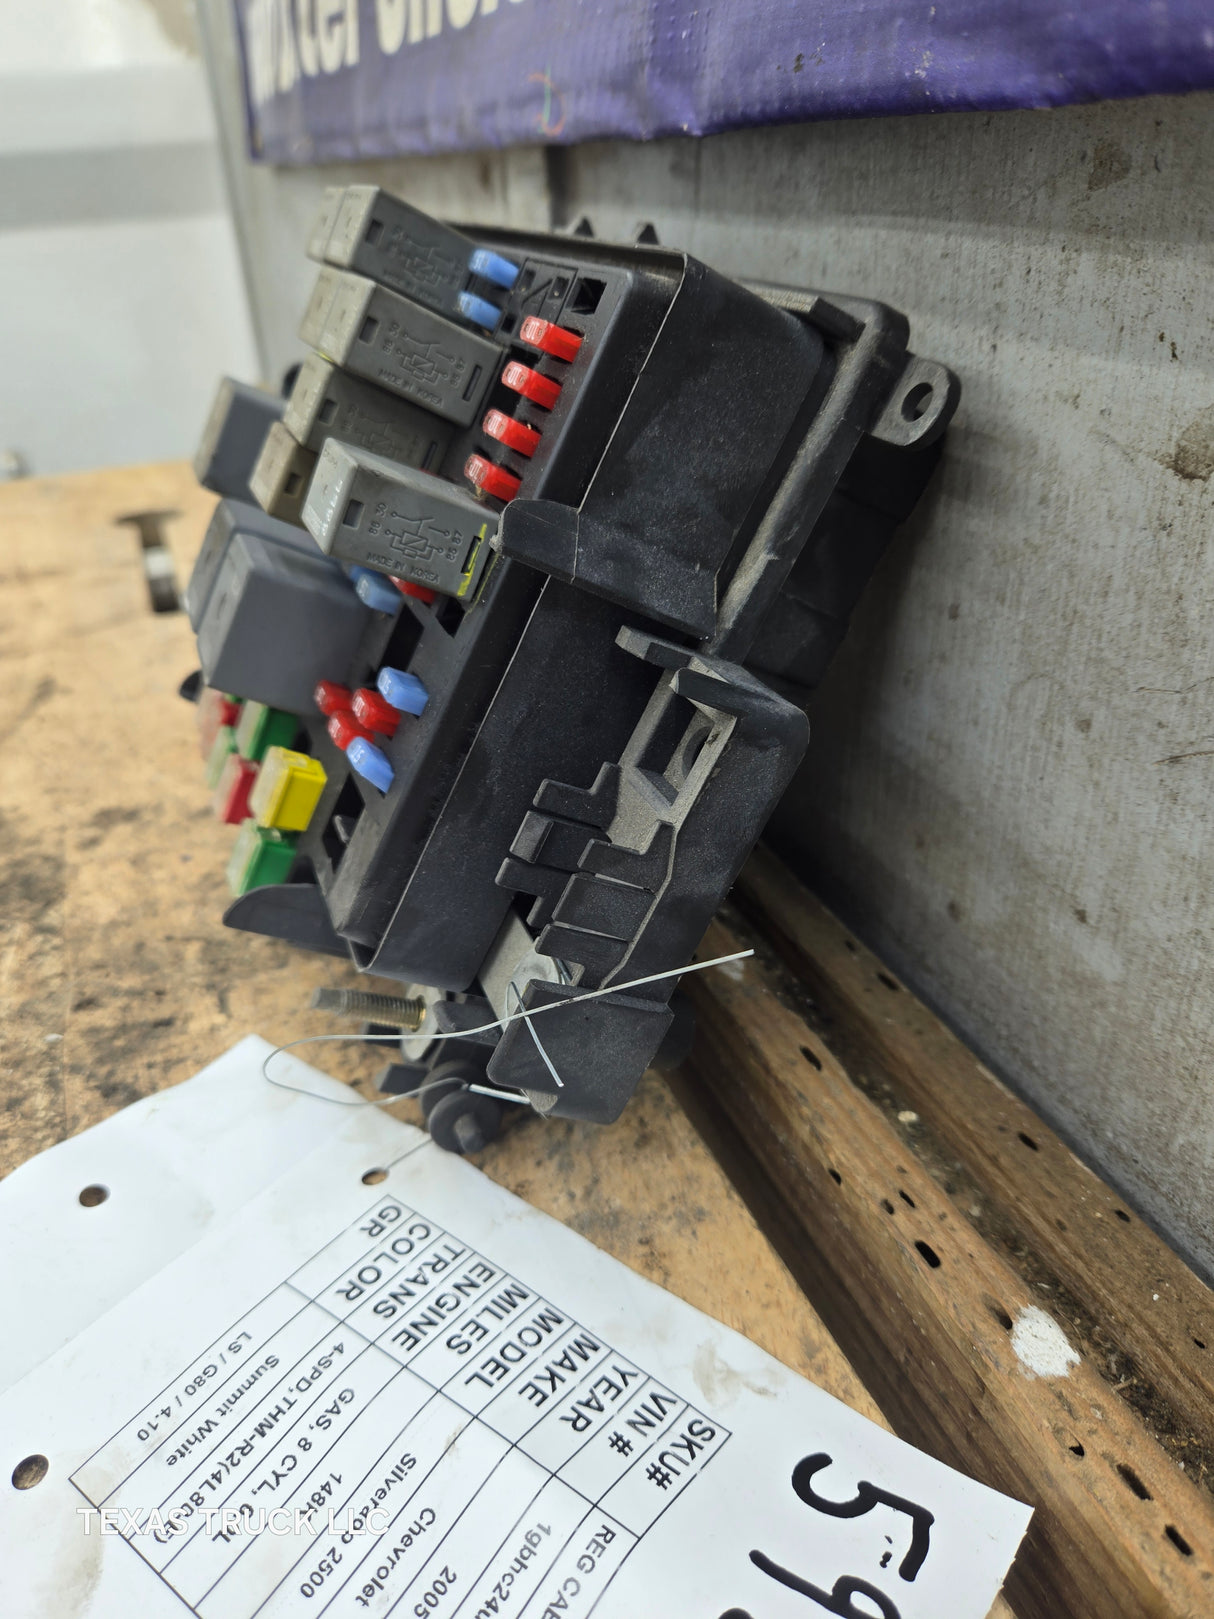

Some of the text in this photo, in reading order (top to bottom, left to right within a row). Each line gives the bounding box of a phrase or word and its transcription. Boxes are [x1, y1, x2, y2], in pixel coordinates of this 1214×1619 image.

[410, 565, 441, 584] KOREA
[360, 1204, 402, 1238] GR
[336, 1222, 432, 1302] COLOR
[372, 1243, 467, 1320] TRANS
[392, 1261, 498, 1353] ENGINE
[445, 1282, 530, 1356] MILES
[228, 1331, 253, 1355] LS
[464, 1306, 564, 1389] MODEL
[517, 1332, 601, 1408] MAKE
[166, 1354, 280, 1467] Summit White
[184, 1366, 219, 1397] G80
[308, 1388, 356, 1432] GAS,
[558, 1364, 639, 1434] YEAR
[136, 1405, 173, 1442] 4.10
[297, 1437, 314, 1453] 8
[607, 1390, 678, 1457] VIN #
[250, 1454, 299, 1497] CYL,
[645, 1418, 716, 1491] SKU#
[300, 1547, 343, 1598] 2500
[355, 1507, 437, 1607] Chevrolet
[576, 1524, 617, 1575] REG
[413, 1565, 458, 1619] 2005
